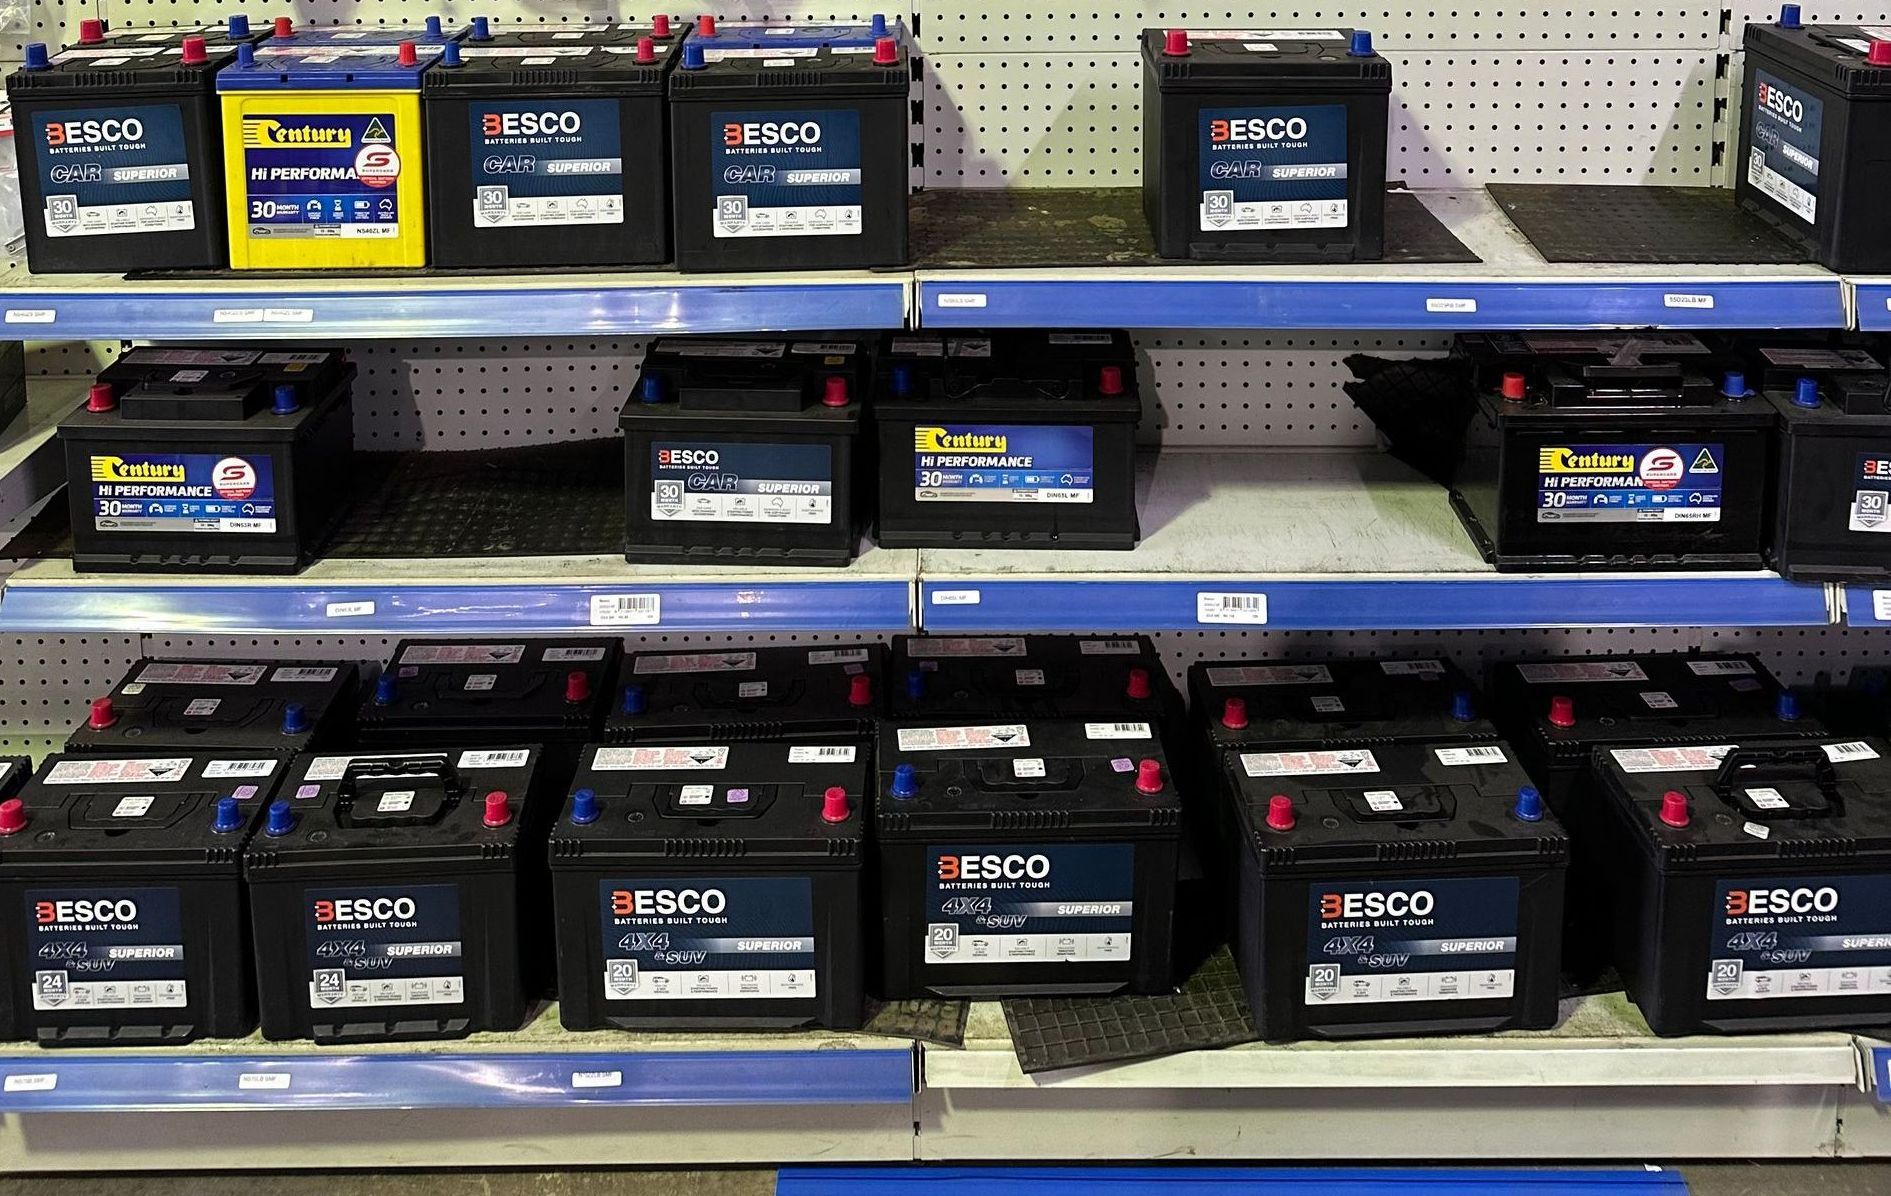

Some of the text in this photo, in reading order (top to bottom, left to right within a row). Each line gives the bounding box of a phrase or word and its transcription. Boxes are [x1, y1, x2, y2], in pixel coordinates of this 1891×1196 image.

[1759, 82, 1803, 123] BESCO
[483, 112, 580, 135] BESCO
[1211, 118, 1307, 142] BESCO
[46, 118, 143, 145] BESCO
[243, 119, 351, 148] Century
[724, 122, 821, 145] BESCO
[485, 137, 527, 145] BATTERIES
[1213, 142, 1254, 151] BATTERIES
[1281, 141, 1308, 149] TOUGH
[1756, 121, 1813, 170] CAR SUPERIOR
[50, 146, 91, 154] BATTERIES
[119, 143, 146, 151] TOUGH
[726, 147, 768, 155] BATTERIES
[484, 155, 611, 174] CAR SUPERIOR
[1752, 152, 1762, 167] 30
[51, 164, 178, 183] CAR SUPERIOR
[252, 167, 361, 180] Hi PERFORMA
[724, 165, 850, 184] CAR SUPERIOR
[1210, 160, 1336, 179] CAR SUPERIOR
[484, 191, 502, 204] 30
[1210, 196, 1228, 208] 30
[53, 201, 72, 213] 30
[251, 201, 277, 218] 30
[723, 201, 742, 214] 30
[915, 427, 1007, 453] Century
[659, 450, 719, 465] BESCO
[921, 456, 1033, 468] Hi PERFORMANCE
[1540, 447, 1634, 473] Century
[91, 456, 185, 482] Century
[1863, 460, 1891, 475] BE
[688, 472, 820, 494] CAR SUPERIOR
[920, 472, 942, 487] 30
[1545, 477, 1558, 487] Hi
[1561, 476, 1645, 488] PERFORMAN
[99, 485, 113, 497] Hi
[115, 485, 212, 498] PERFORMANCE
[660, 485, 679, 498] 30
[1543, 492, 1566, 508] 30
[1861, 496, 1881, 509] 30
[99, 501, 121, 517] 30
[938, 855, 1050, 880] BESCO
[939, 880, 1050, 890] BATTERIES BUILT TOUGH
[612, 889, 725, 915] BESCO
[1321, 890, 1434, 918] BESCO
[1726, 887, 1838, 915] BESCO
[36, 900, 136, 923] BESCO
[315, 898, 415, 921] BESCO
[1057, 904, 1122, 915] SUPERIOR
[614, 916, 727, 925] BATTERIES BUILT TOUGH
[1321, 918, 1434, 929] BATTERIES BUILT TOUGH
[1726, 915, 1837, 925] BATTERIES BUILT TOUGH
[39, 924, 82, 932] BATTERIES
[111, 923, 138, 931] TOUGH
[317, 923, 361, 931] BATTERIES
[934, 928, 953, 941] 20
[737, 939, 803, 951] SUPERIOR
[1440, 941, 1504, 952] SUPERIOR
[1842, 937, 1891, 949] SUPERI
[108, 948, 175, 960] SUPERIOR
[386, 945, 453, 957] SUPERIOR
[613, 965, 632, 977] 20
[1315, 969, 1334, 982] 20
[1717, 965, 1737, 977] 20
[43, 975, 62, 988] 24
[320, 974, 339, 987] 24
